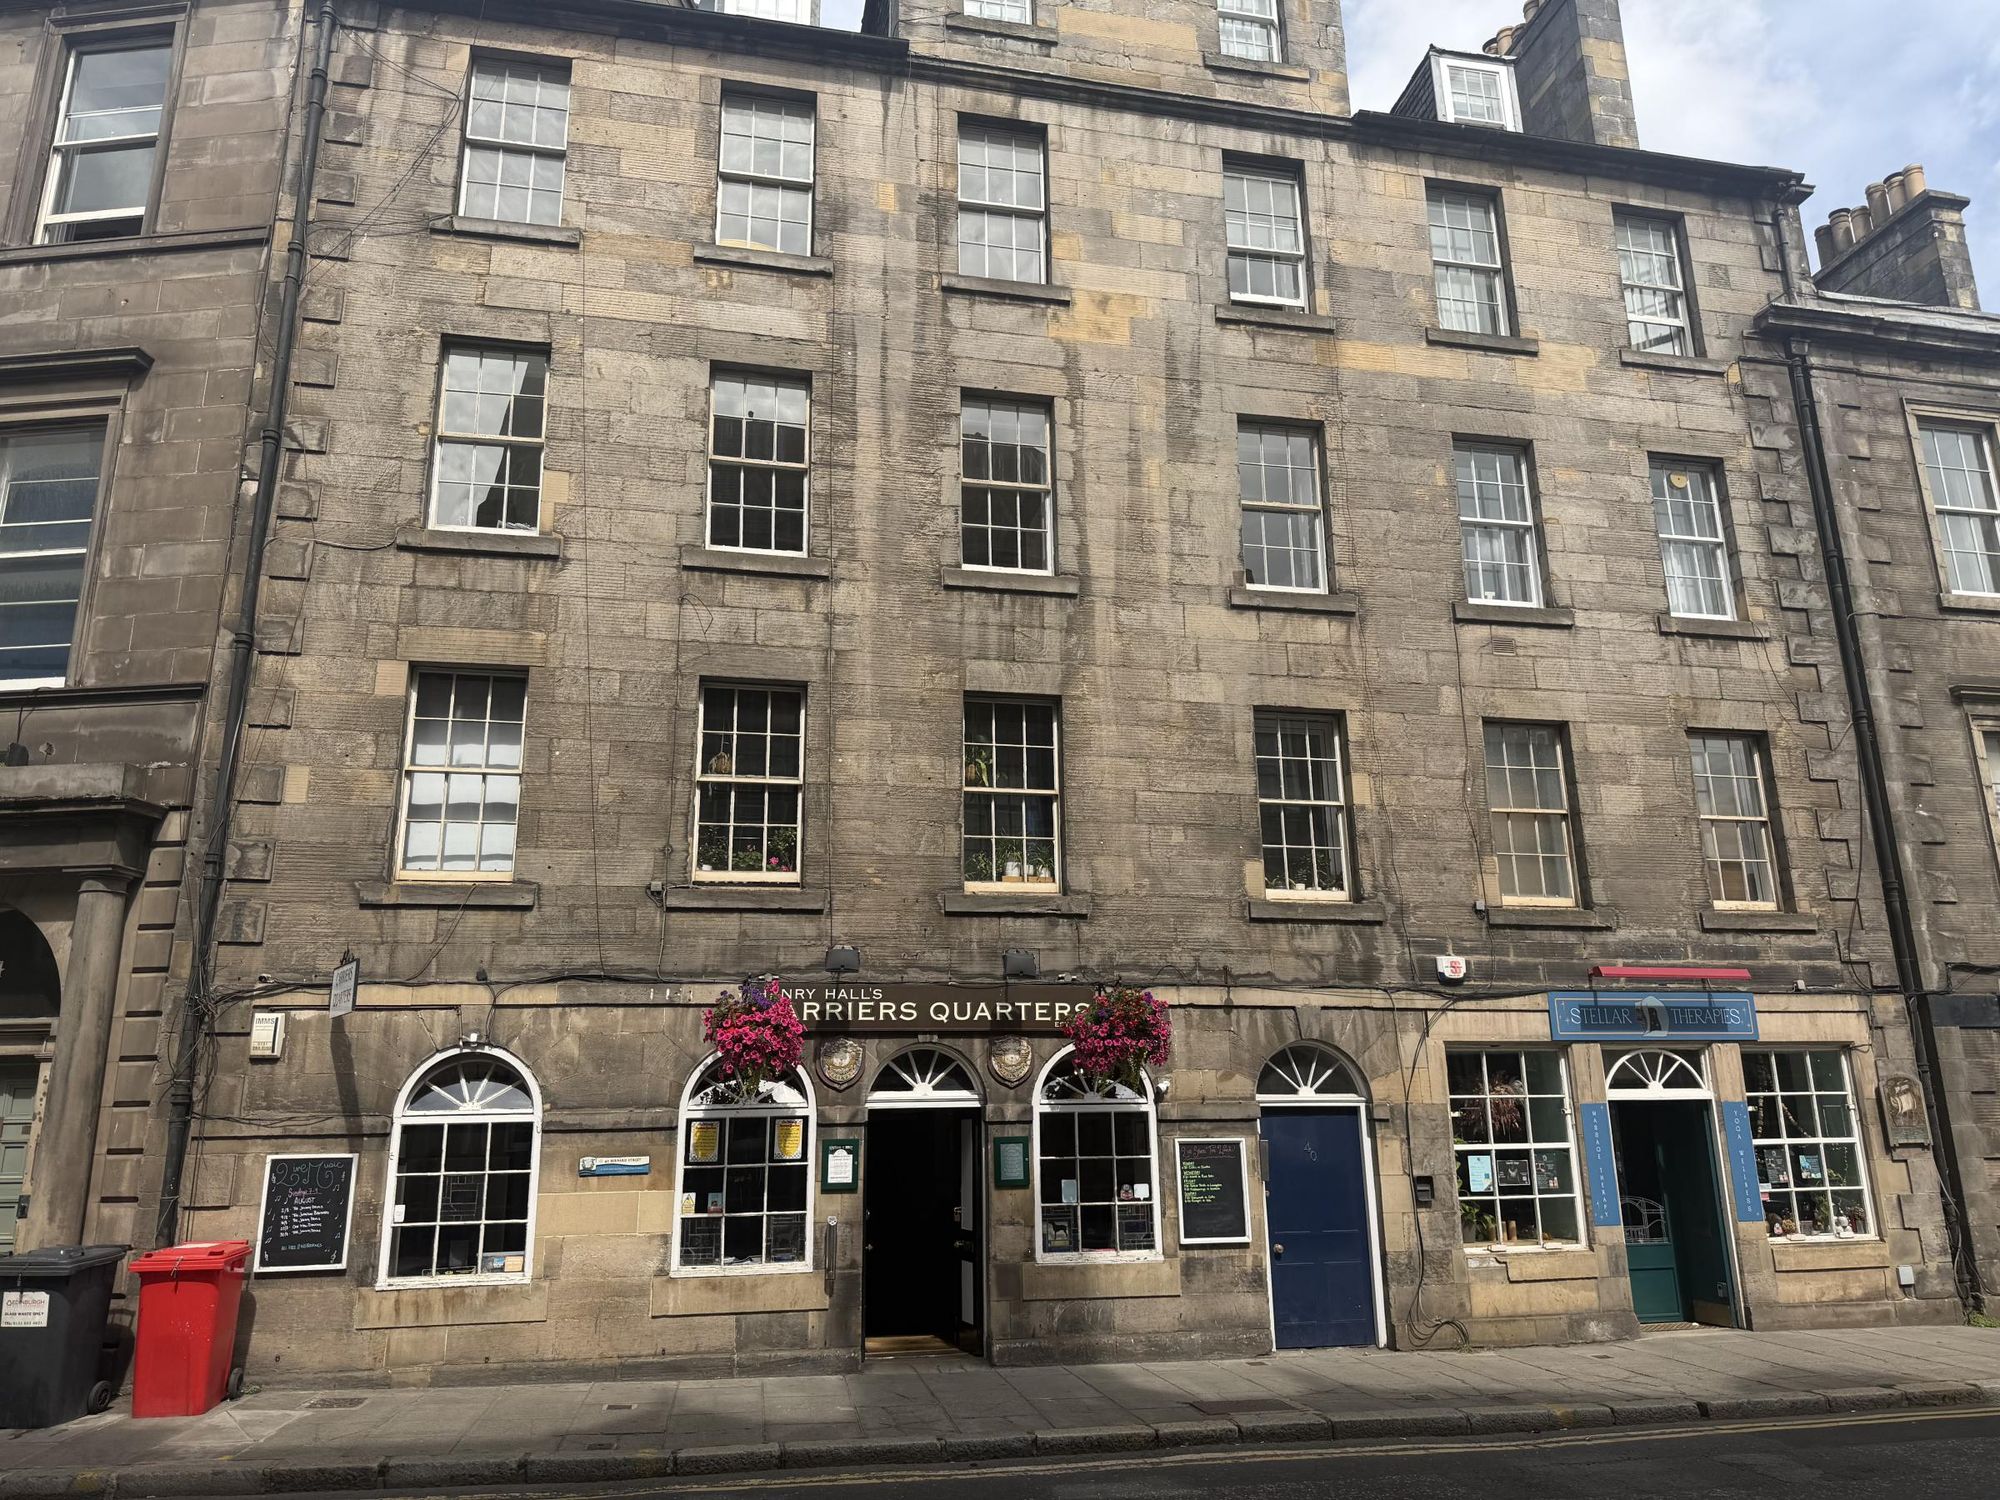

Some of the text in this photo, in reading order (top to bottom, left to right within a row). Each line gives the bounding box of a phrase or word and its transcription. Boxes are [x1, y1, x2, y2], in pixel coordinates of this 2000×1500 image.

[825, 988, 883, 999] HALL'S
[1570, 1007, 1741, 1025] STELLAR THERAPIES
[1304, 1139, 1317, 1161] 40
[1733, 1110, 1752, 1212] YOGA WELLNESS
[1591, 1110, 1609, 1217] MASSAGE THERAPY
